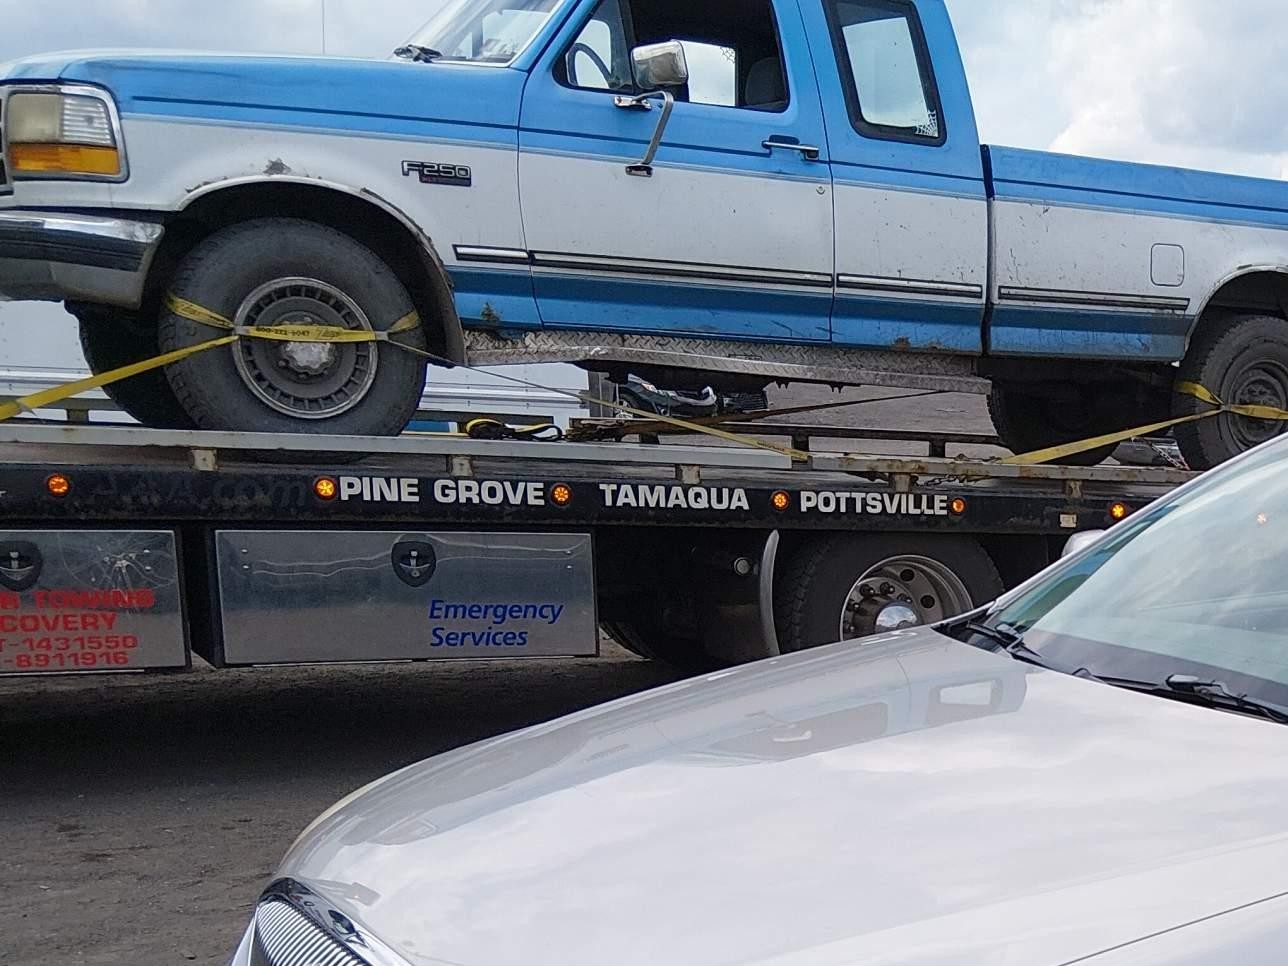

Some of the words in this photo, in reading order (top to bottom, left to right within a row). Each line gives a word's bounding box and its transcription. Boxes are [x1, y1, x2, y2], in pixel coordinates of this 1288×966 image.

[401, 160, 471, 178] F250
[339, 476, 420, 502] PINE
[433, 479, 545, 505] GROVE
[599, 484, 750, 511] TAMAQUA
[800, 491, 948, 515] POTTSVILLE
[429, 600, 564, 624] Emergency
[430, 627, 528, 647] Services
